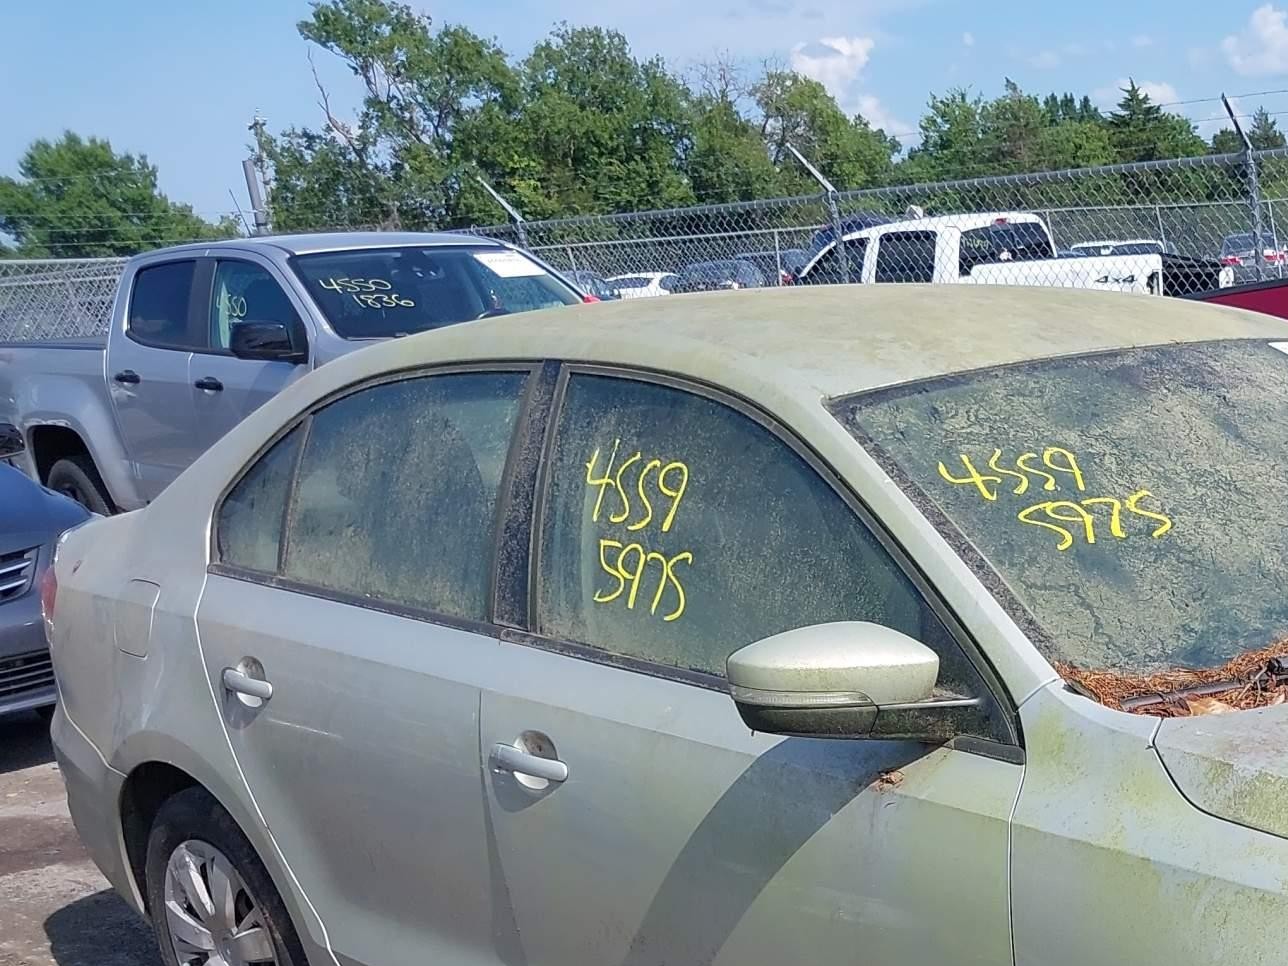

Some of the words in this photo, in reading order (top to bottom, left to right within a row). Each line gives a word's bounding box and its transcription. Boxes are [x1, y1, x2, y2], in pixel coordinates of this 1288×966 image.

[319, 277, 392, 294] 4550
[352, 293, 415, 309] 1836
[586, 438, 689, 532] 4559
[938, 446, 1086, 501] 4559
[1017, 490, 1175, 551] 5975
[592, 538, 693, 622] 5975
